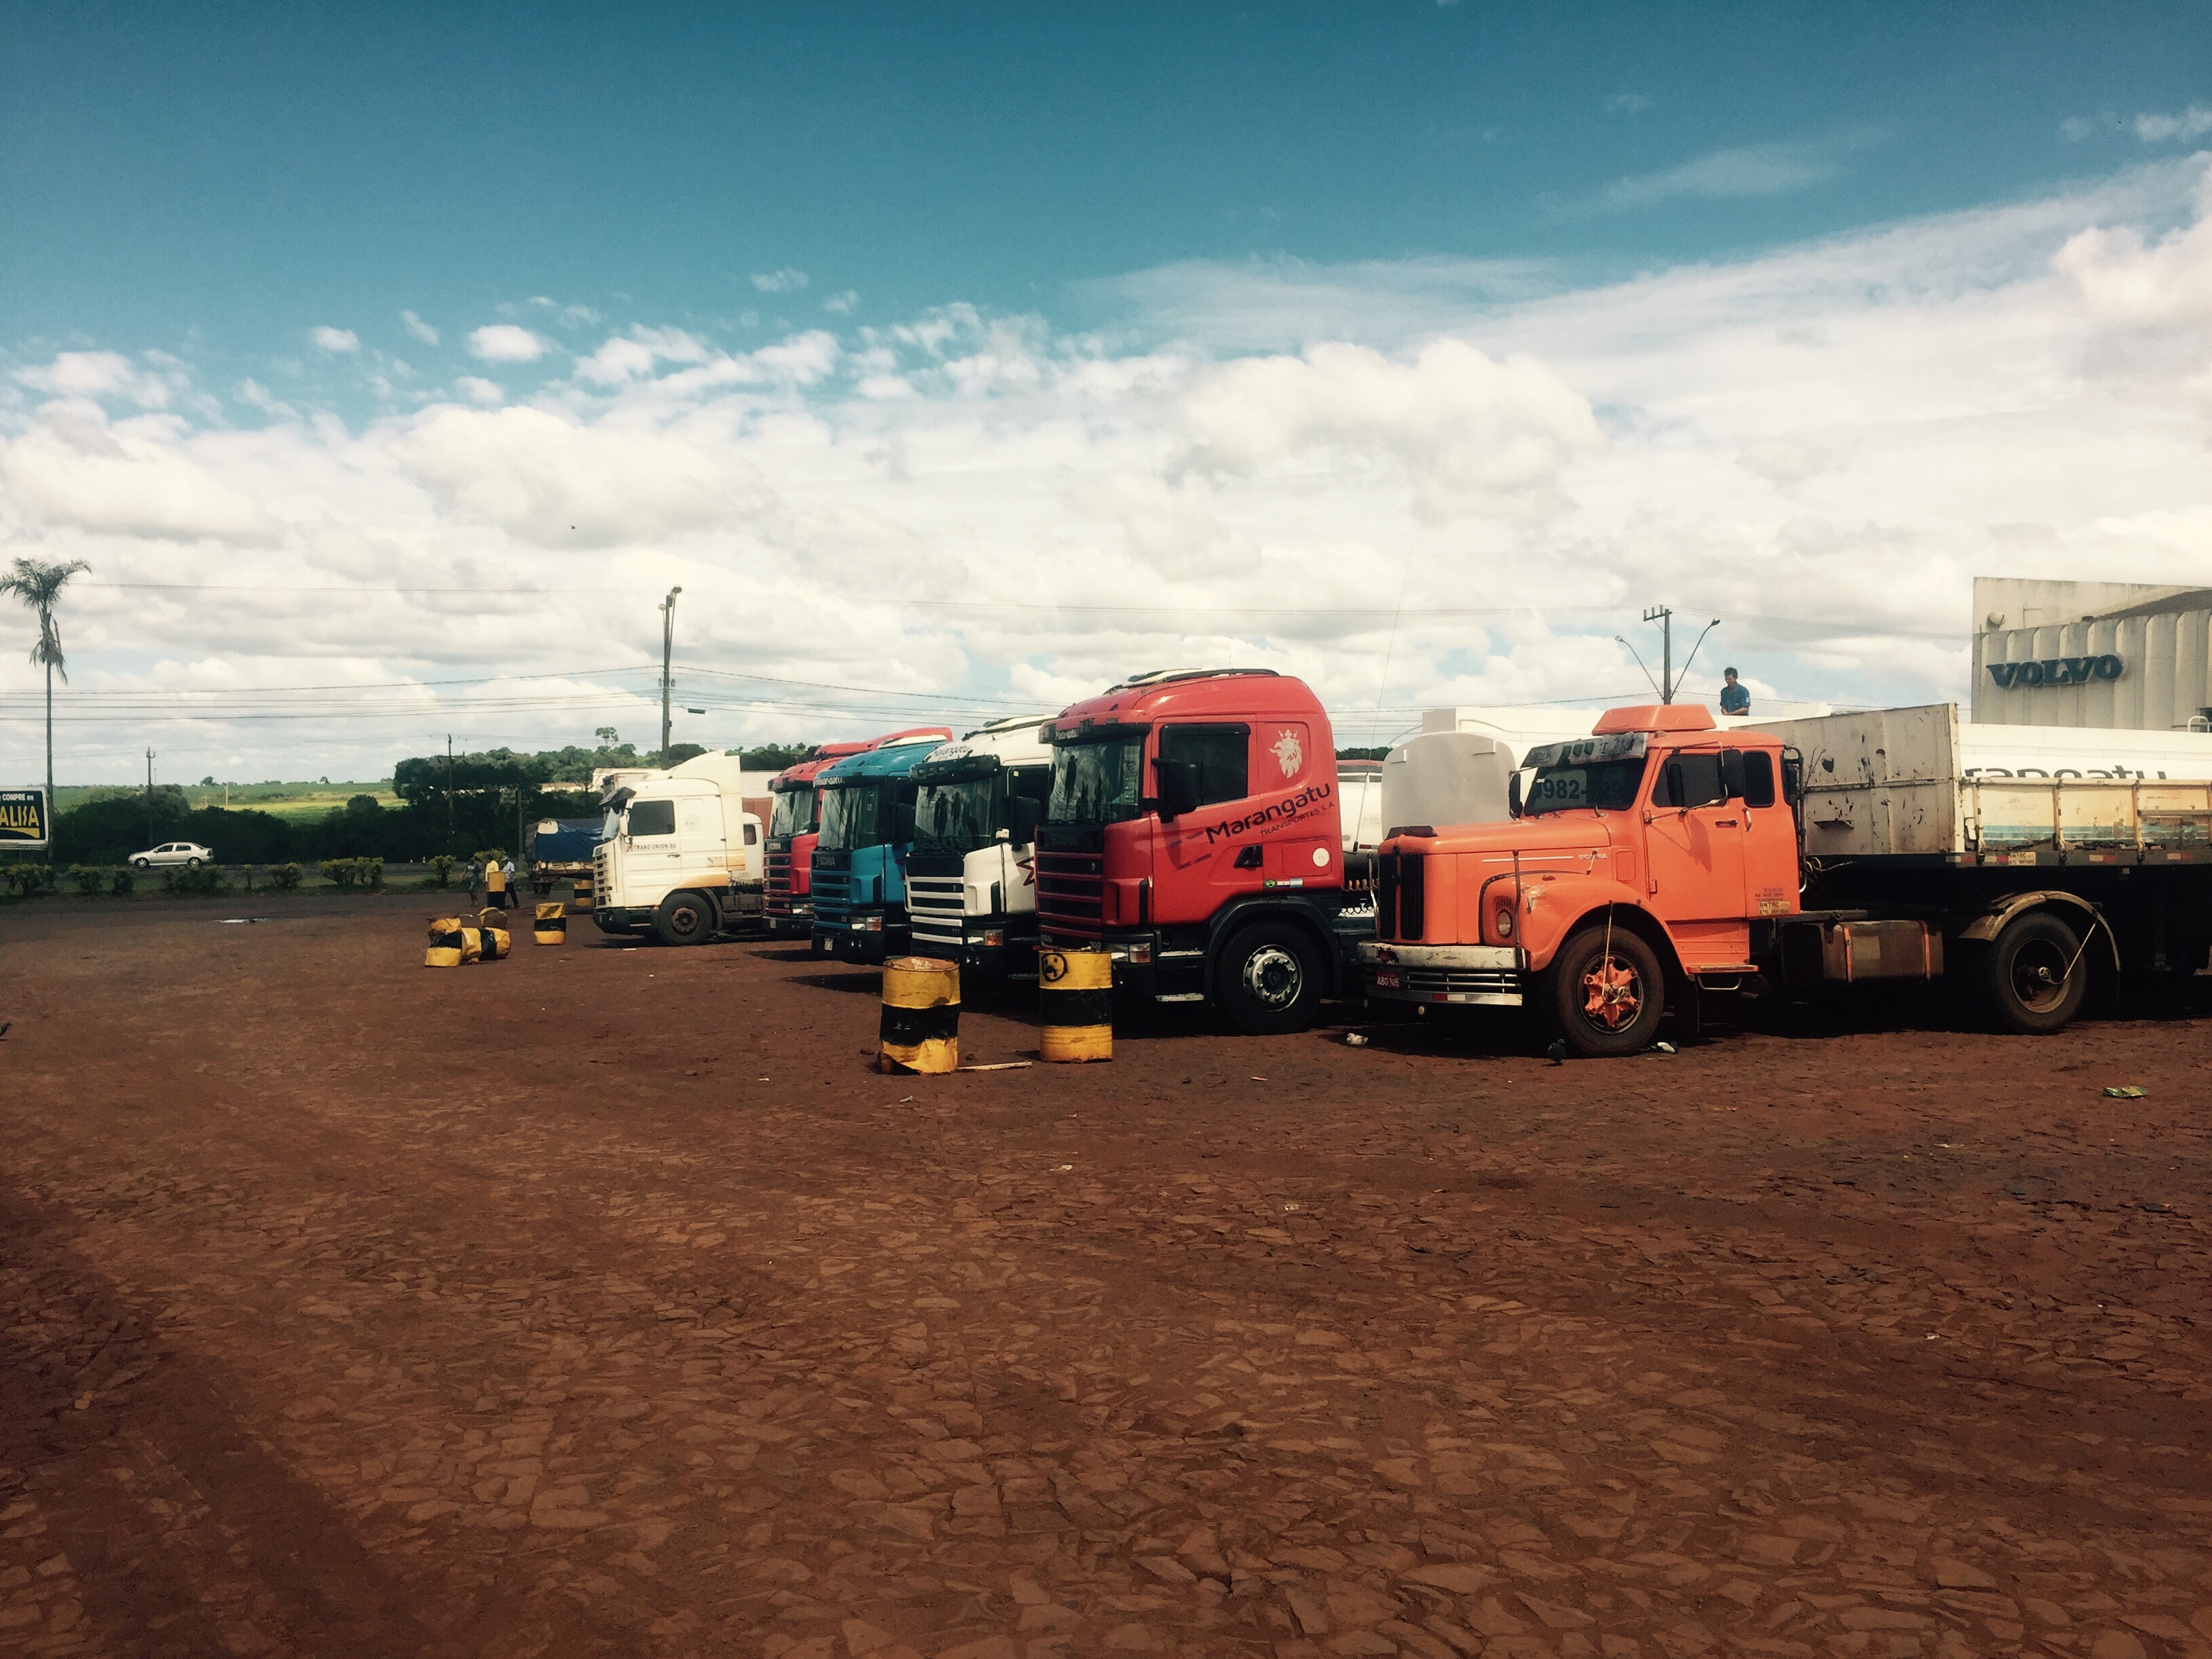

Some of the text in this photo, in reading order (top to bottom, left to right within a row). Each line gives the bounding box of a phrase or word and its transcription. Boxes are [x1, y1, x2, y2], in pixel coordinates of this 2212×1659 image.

[1986, 654, 2123, 687] VOLVO
[2, 793, 26, 801] COMPRE
[1206, 783, 1330, 844] Marangatu
[1259, 808, 1320, 837] TRANSPORTES
